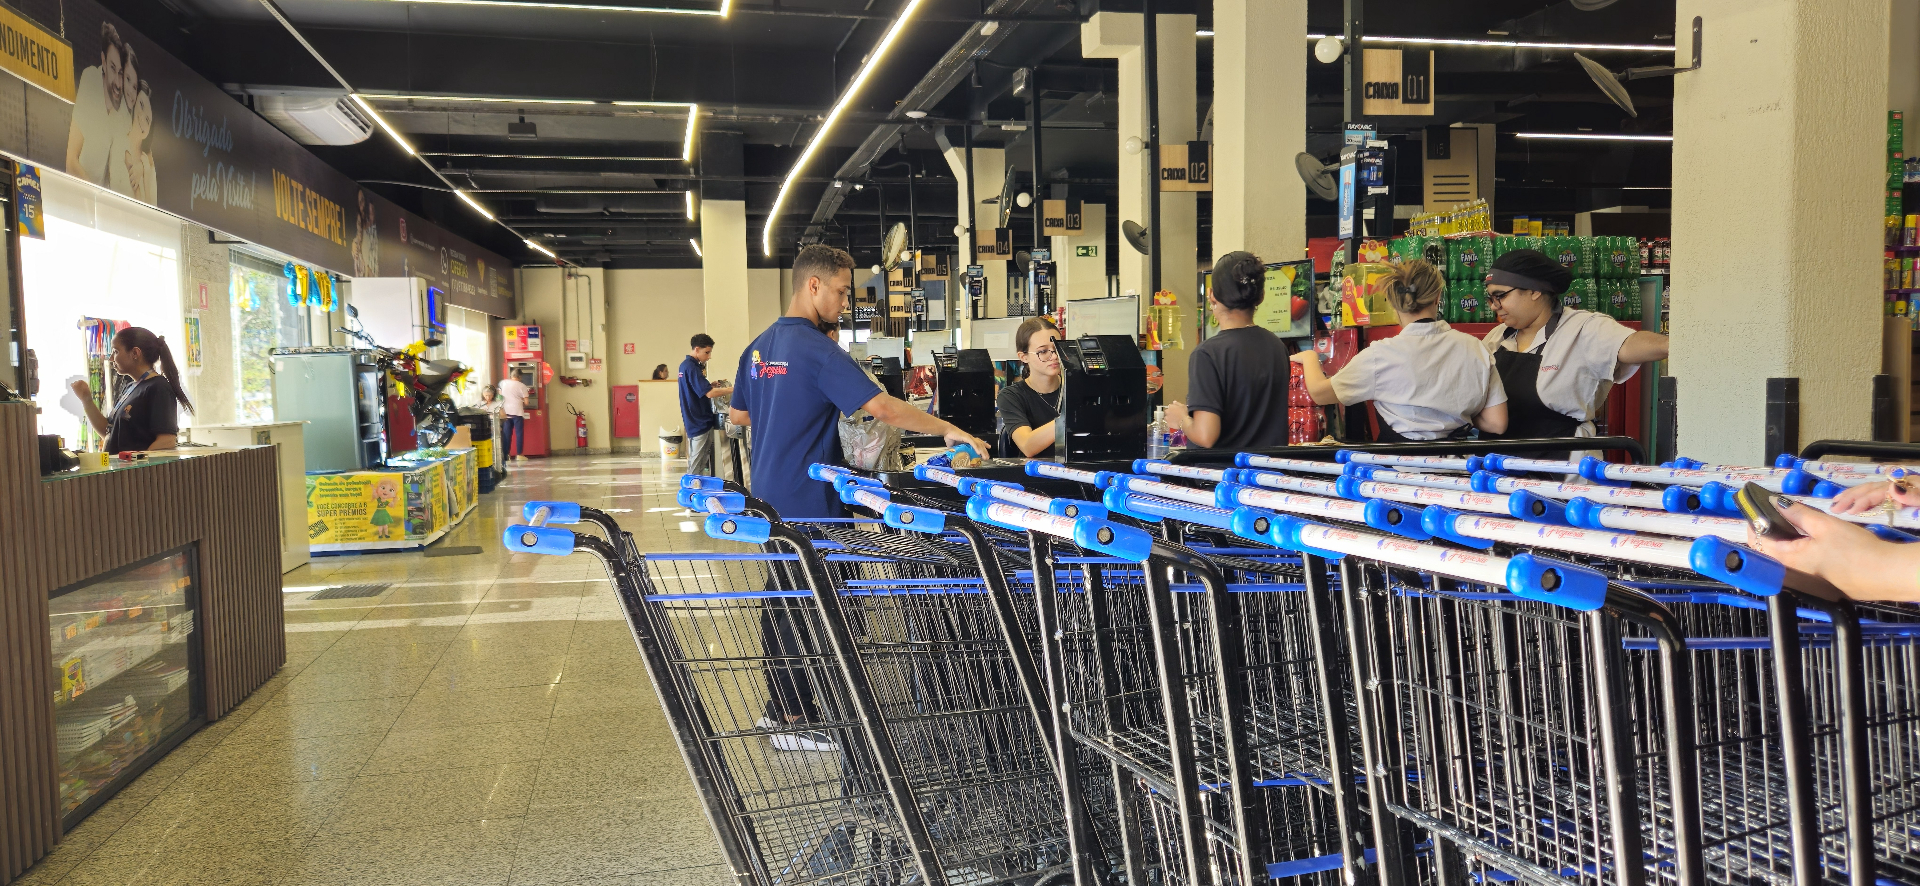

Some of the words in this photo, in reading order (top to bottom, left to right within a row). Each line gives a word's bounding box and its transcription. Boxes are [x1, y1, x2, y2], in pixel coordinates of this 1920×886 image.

[1365, 82, 1399, 100] CAIXA
[1407, 75, 1424, 100] 01
[172, 89, 233, 158] Obrigado
[1161, 167, 1187, 181] CAIXA
[1190, 162, 1206, 181] 02
[16, 176, 41, 192] CAMEL
[191, 163, 220, 211] pela
[216, 161, 256, 211] Visita!
[272, 171, 306, 230] VOLTE
[1045, 217, 1064, 228] CAIXA
[1067, 213, 1080, 228] 03
[977, 245, 995, 254] CAIXA
[997, 241, 1009, 254] 04
[1460, 253, 1479, 263] FANTA
[1558, 253, 1578, 263] FANTA
[1610, 253, 1627, 263] FANTA
[921, 267, 936, 275] CAIXA
[937, 265, 947, 275] 05
[1460, 297, 1479, 307] FANTA
[1563, 296, 1582, 307] FANTA
[1610, 294, 1628, 304] FANTA
[317, 509, 338, 518] SUPER
